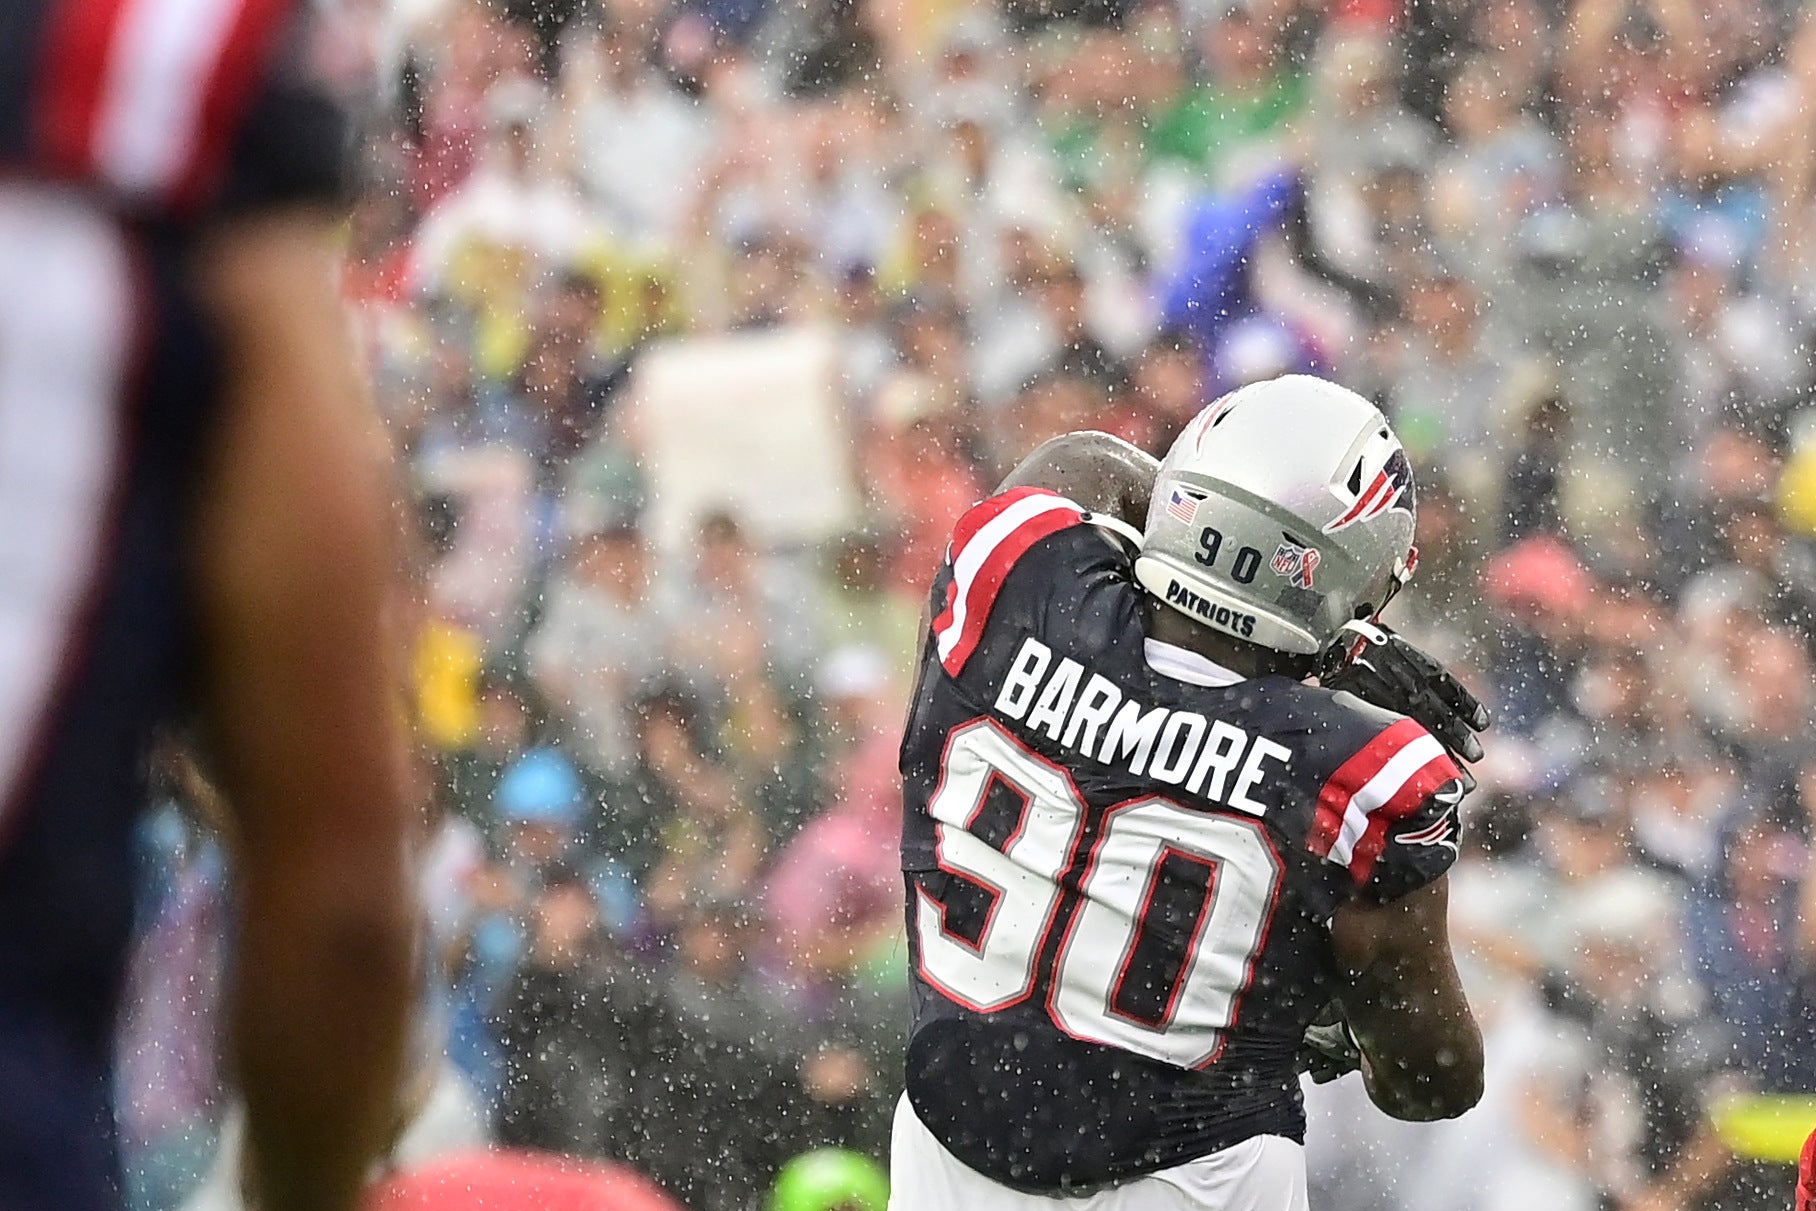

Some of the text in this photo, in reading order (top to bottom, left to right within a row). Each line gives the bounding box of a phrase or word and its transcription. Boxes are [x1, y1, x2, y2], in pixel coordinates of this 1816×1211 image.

[1195, 526, 1262, 584] 90
[1272, 556, 1296, 574] NFL
[1166, 578, 1256, 637] PATRIOTS
[994, 637, 1292, 816] BARMORE
[915, 714, 1285, 1070] 90
